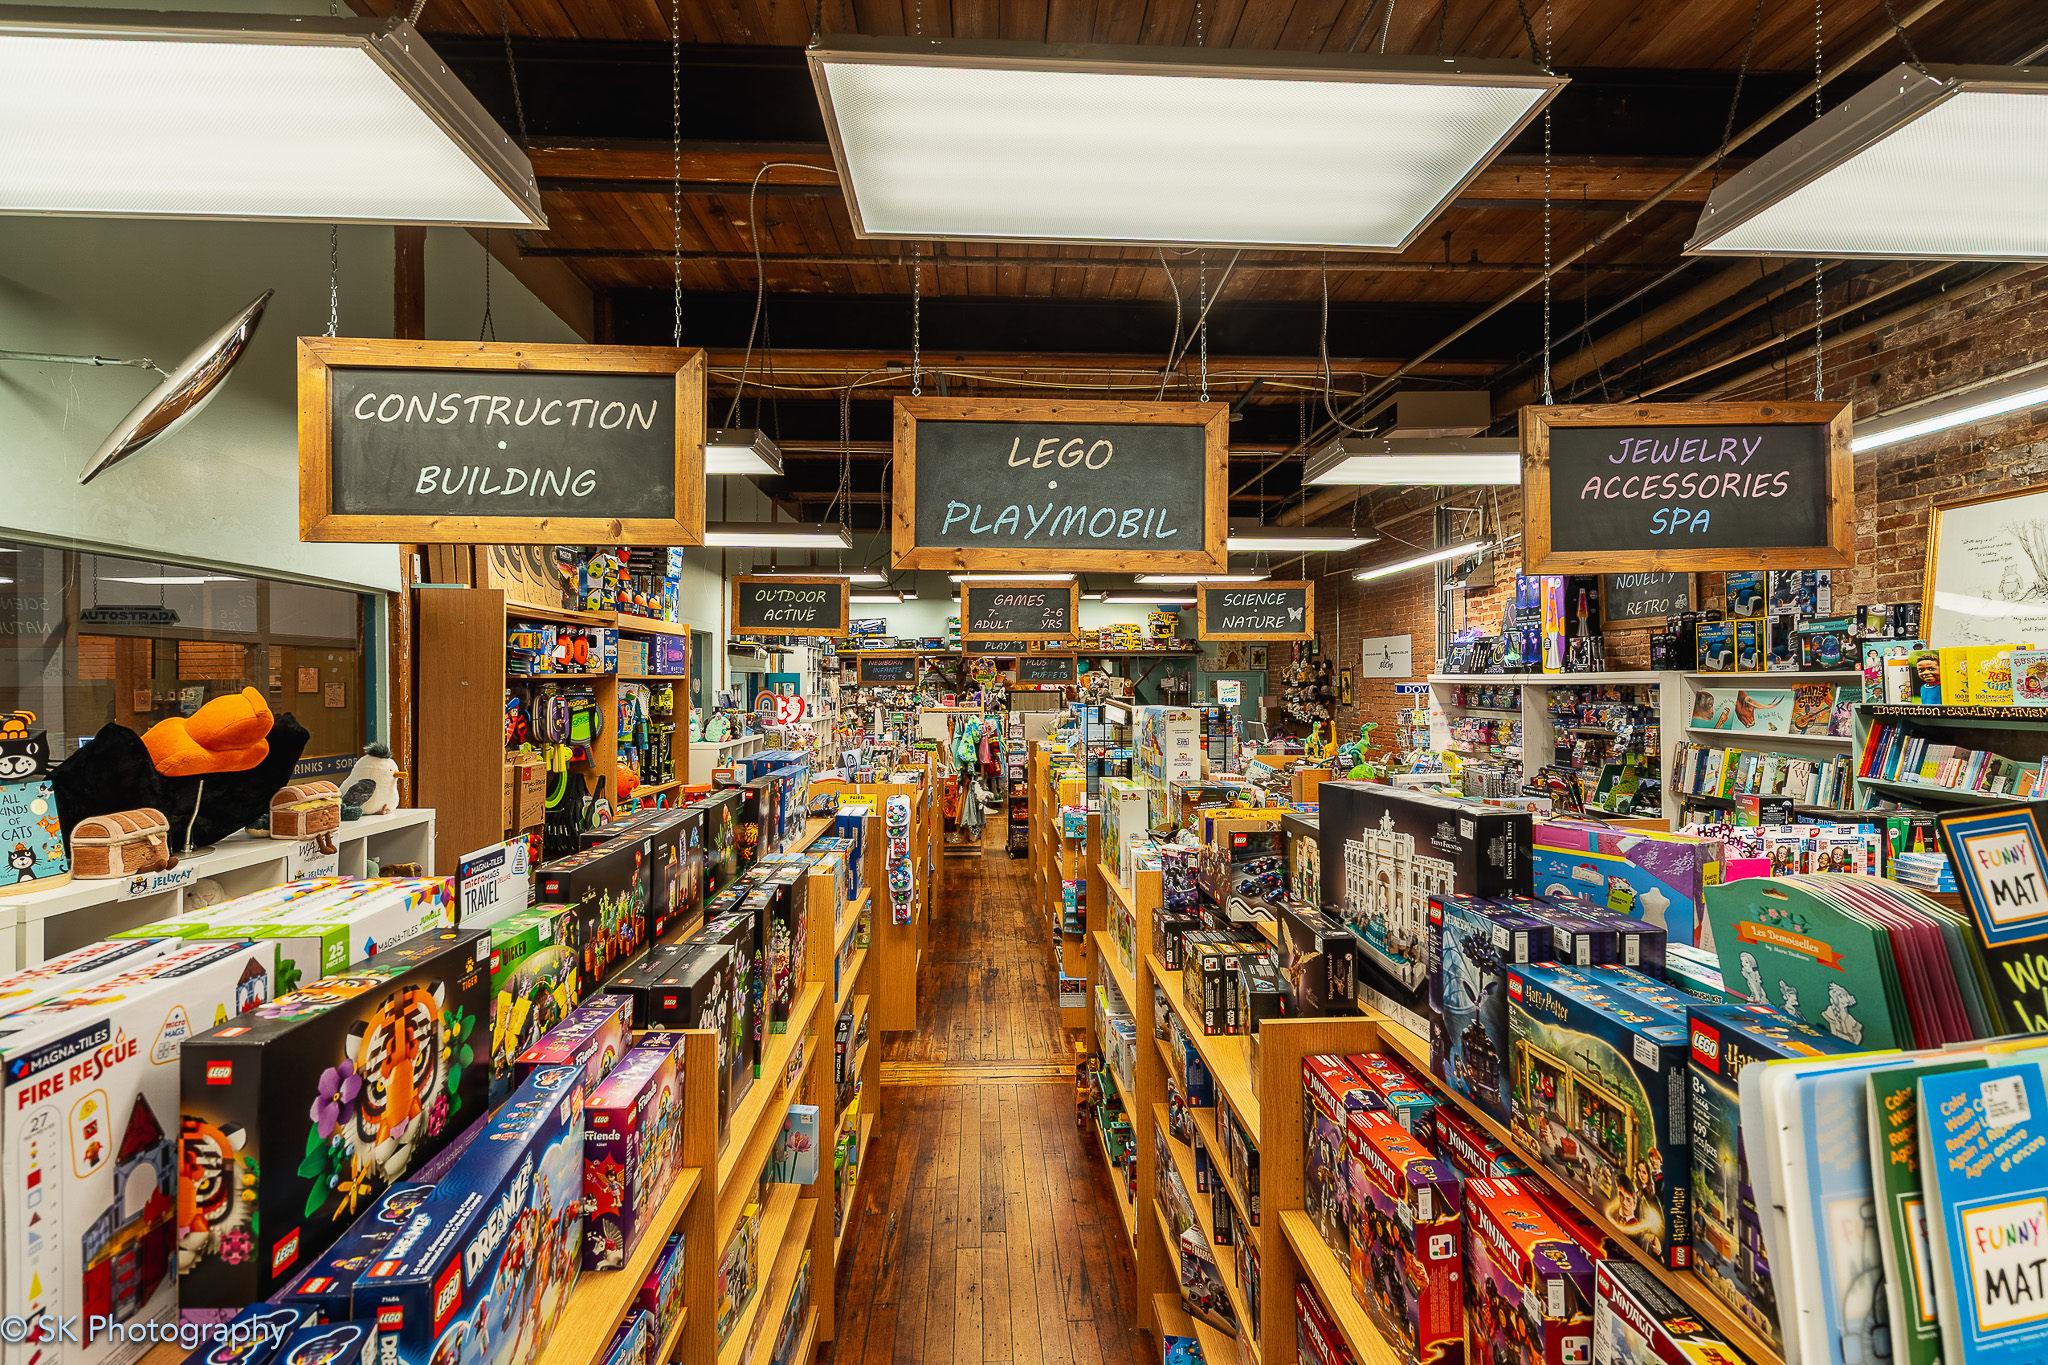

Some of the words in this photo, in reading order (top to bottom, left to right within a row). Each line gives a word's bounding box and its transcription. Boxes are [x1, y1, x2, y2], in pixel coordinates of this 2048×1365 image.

[353, 391, 658, 430] CONSTRUCTION
[1007, 437, 1114, 470] LEGO
[1608, 436, 1762, 465] JEWELRY
[415, 465, 597, 497] BUILDING
[1580, 470, 1790, 500] ACCESSORIES
[941, 500, 1178, 539] PLAYMOBIL
[1649, 507, 1711, 534] SPA
[755, 589, 827, 604] OUTDOOR
[993, 593, 1047, 608] GAMES
[1222, 592, 1287, 608] SCIENCE
[1625, 598, 1670, 616] RETRO
[80, 611, 178, 621] AUTOSTRADA
[763, 607, 817, 622] ACTIVE
[1042, 607, 1064, 618] 2-6
[1221, 615, 1286, 630] NATURE
[973, 619, 1013, 631] ADULT
[1040, 618, 1064, 630] YRS
[984, 641, 1011, 651] PLAY
[868, 659, 904, 667] NEWBORN
[872, 666, 903, 674] INFANTS
[1031, 671, 1068, 679] PUPPETS
[3, 794, 20, 805] ALL
[9, 817, 21, 826] OF
[1, 826, 32, 841] CATS
[471, 855, 503, 875] MAGNA-TILES
[1978, 842, 2027, 870] FUNNY
[465, 879, 500, 915] TRAVEL
[1990, 873, 2038, 907] MAT
[419, 908, 441, 926] JUNGLE
[1430, 907, 1441, 918] LEGO
[378, 924, 418, 952] MAGNA-TILES
[1751, 926, 1766, 937] Les
[1767, 930, 1819, 953] Demoiselles
[328, 940, 344, 961] 25
[338, 954, 346, 963] SET
[502, 940, 527, 966] WICKED
[490, 955, 500, 970] EGO
[462, 974, 478, 991] TIGER
[1509, 981, 1523, 995] LEGO
[1525, 985, 1545, 1010] Harry
[1546, 994, 1569, 1022] Potter
[1711, 994, 1723, 1004] KIT
[164, 1026, 185, 1038] MAGS
[165, 1019, 186, 1029] micro
[31, 1029, 109, 1073] MAGNA-TILES
[1693, 1033, 1717, 1057] LEGO
[18, 1072, 64, 1111] FIRE
[69, 1037, 138, 1082] RESCUE
[207, 1067, 230, 1078] LEGO
[1310, 1072, 1337, 1117] NINJAGO
[1692, 1076, 1706, 1095] 8+
[1940, 1092, 1967, 1116] Color
[29, 1112, 49, 1133] 27
[594, 1115, 609, 1125] LEGO
[1693, 1119, 1707, 1137] 499
[1944, 1107, 1975, 1132] Wash
[584, 1129, 621, 1142] Friends
[1945, 1120, 1981, 1153] Repeat
[1994, 1129, 2028, 1157] encore
[1449, 1127, 1487, 1177] NINJAGO
[1948, 1145, 1979, 1172] Again
[2012, 1135, 2046, 1164] encore
[1358, 1137, 1398, 1197] NINJAGO
[1965, 1153, 1995, 1179] Again
[1673, 1213, 1690, 1243] Harry
[1975, 1217, 2039, 1254] FUNNY
[273, 1236, 298, 1269] LEGO
[1478, 1207, 1523, 1281] NINJAGO
[1676, 1247, 1686, 1265] LEGO
[1598, 1274, 1610, 1291] LEGO
[1985, 1258, 2047, 1306] MAT
[435, 1269, 461, 1322] LEGO
[379, 1313, 401, 1324] LEGO
[1611, 1284, 1656, 1349] NINJAGO
[1303, 1306, 1329, 1361] NINJAGO
